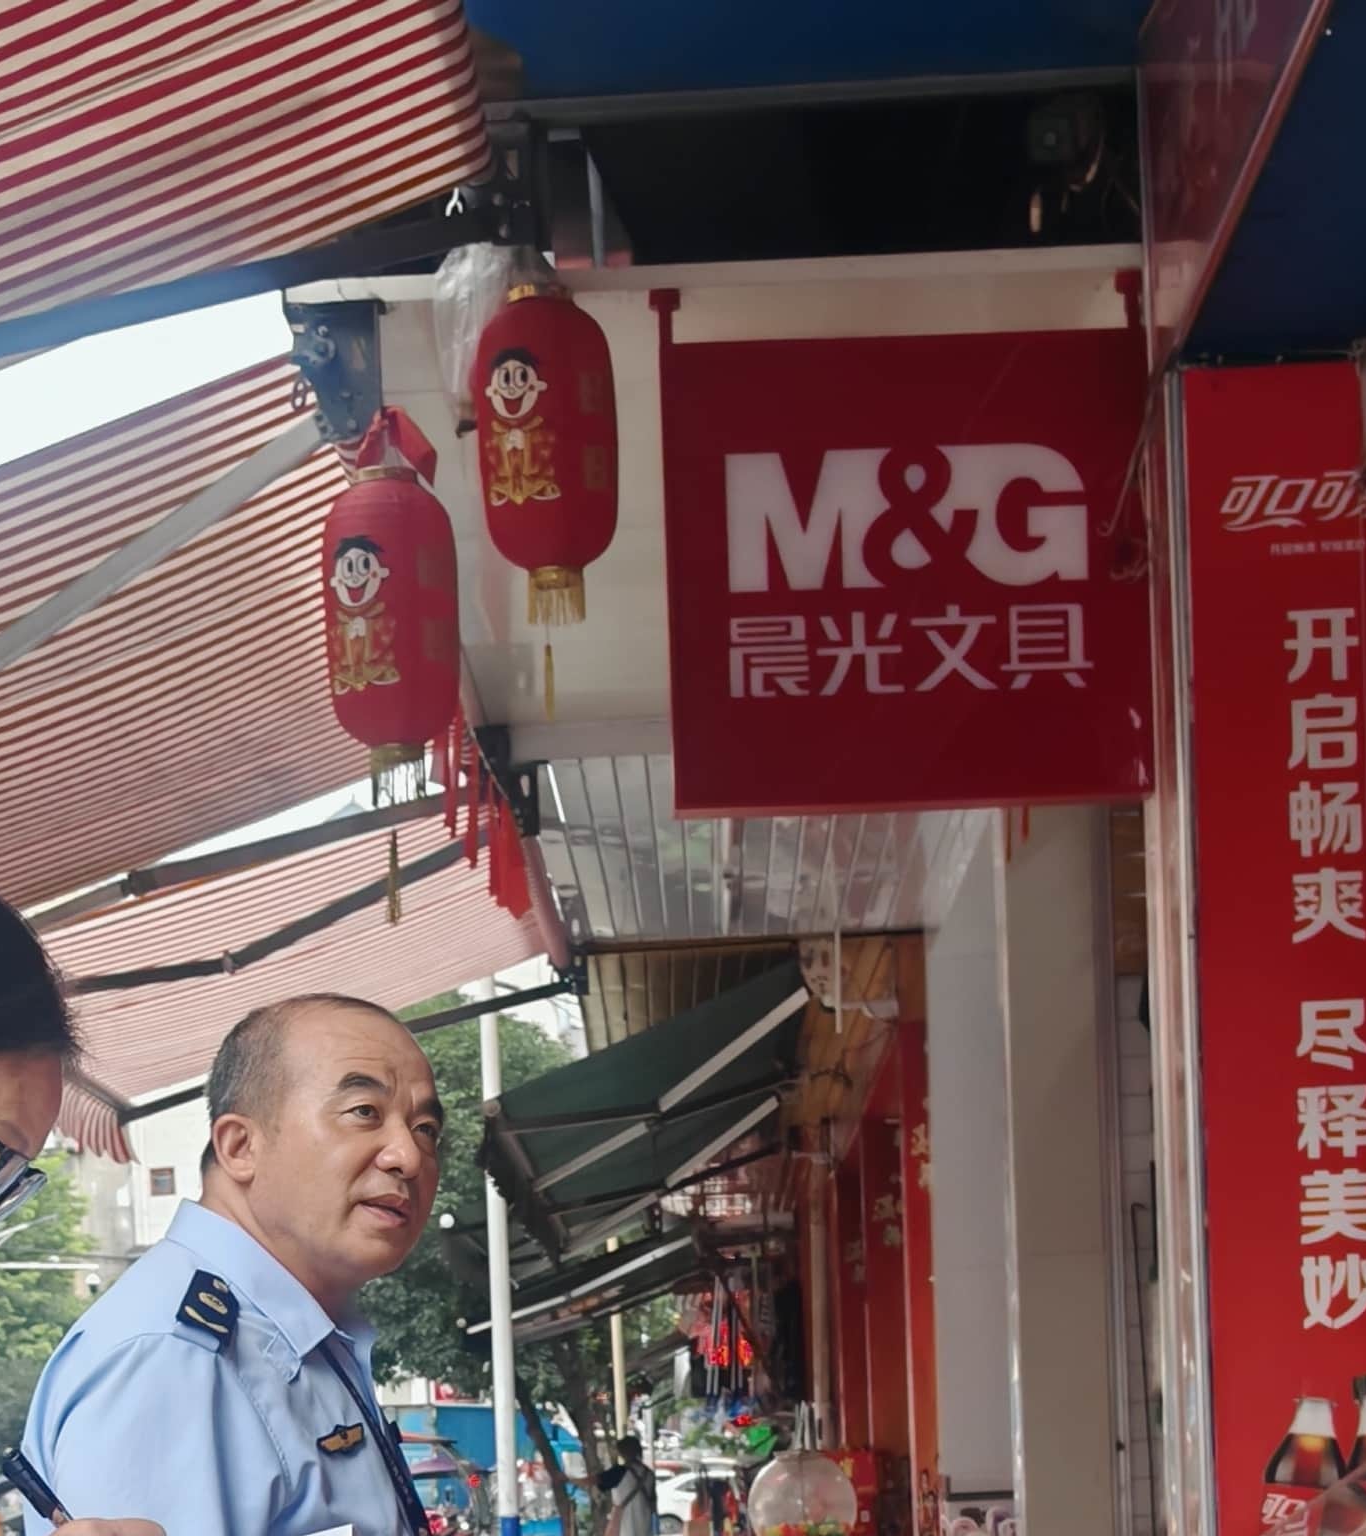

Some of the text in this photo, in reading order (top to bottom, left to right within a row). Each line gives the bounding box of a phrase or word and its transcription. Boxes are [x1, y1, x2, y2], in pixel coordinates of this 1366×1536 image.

[725, 444, 1089, 593] M&G
[729, 603, 1094, 698] 晨光文具
